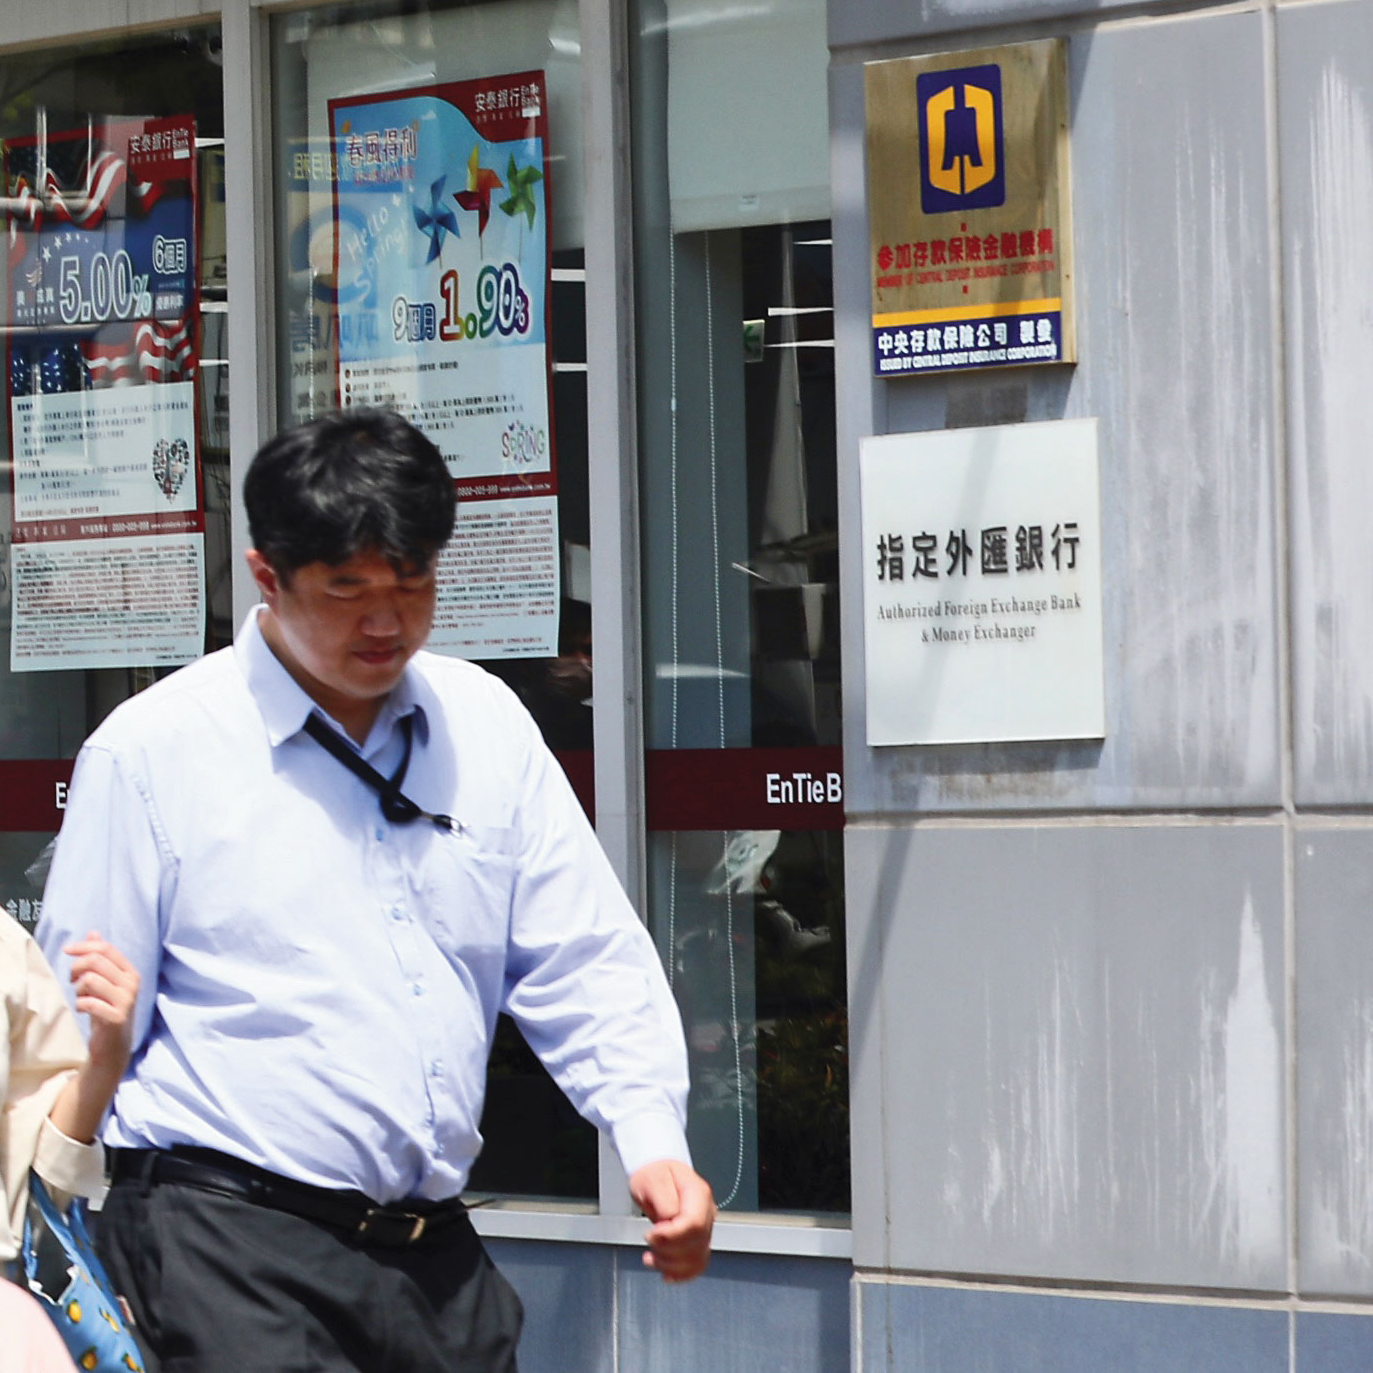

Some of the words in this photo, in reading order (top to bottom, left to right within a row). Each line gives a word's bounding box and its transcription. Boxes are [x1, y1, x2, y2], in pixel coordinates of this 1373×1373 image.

[347, 206, 389, 260] Hello
[59, 249, 152, 324] 5.00%
[440, 263, 531, 342] 1.90%
[877, 522, 1080, 581] 指定外匯銀行
[877, 600, 941, 620] Authorized
[944, 599, 988, 619] Foreign
[991, 594, 1047, 616] Exchange
[1050, 592, 1082, 611] Bank
[932, 626, 971, 645] Money
[974, 623, 1036, 643] Exchanger
[55, 782, 70, 810] E
[766, 773, 824, 804] EnTie
